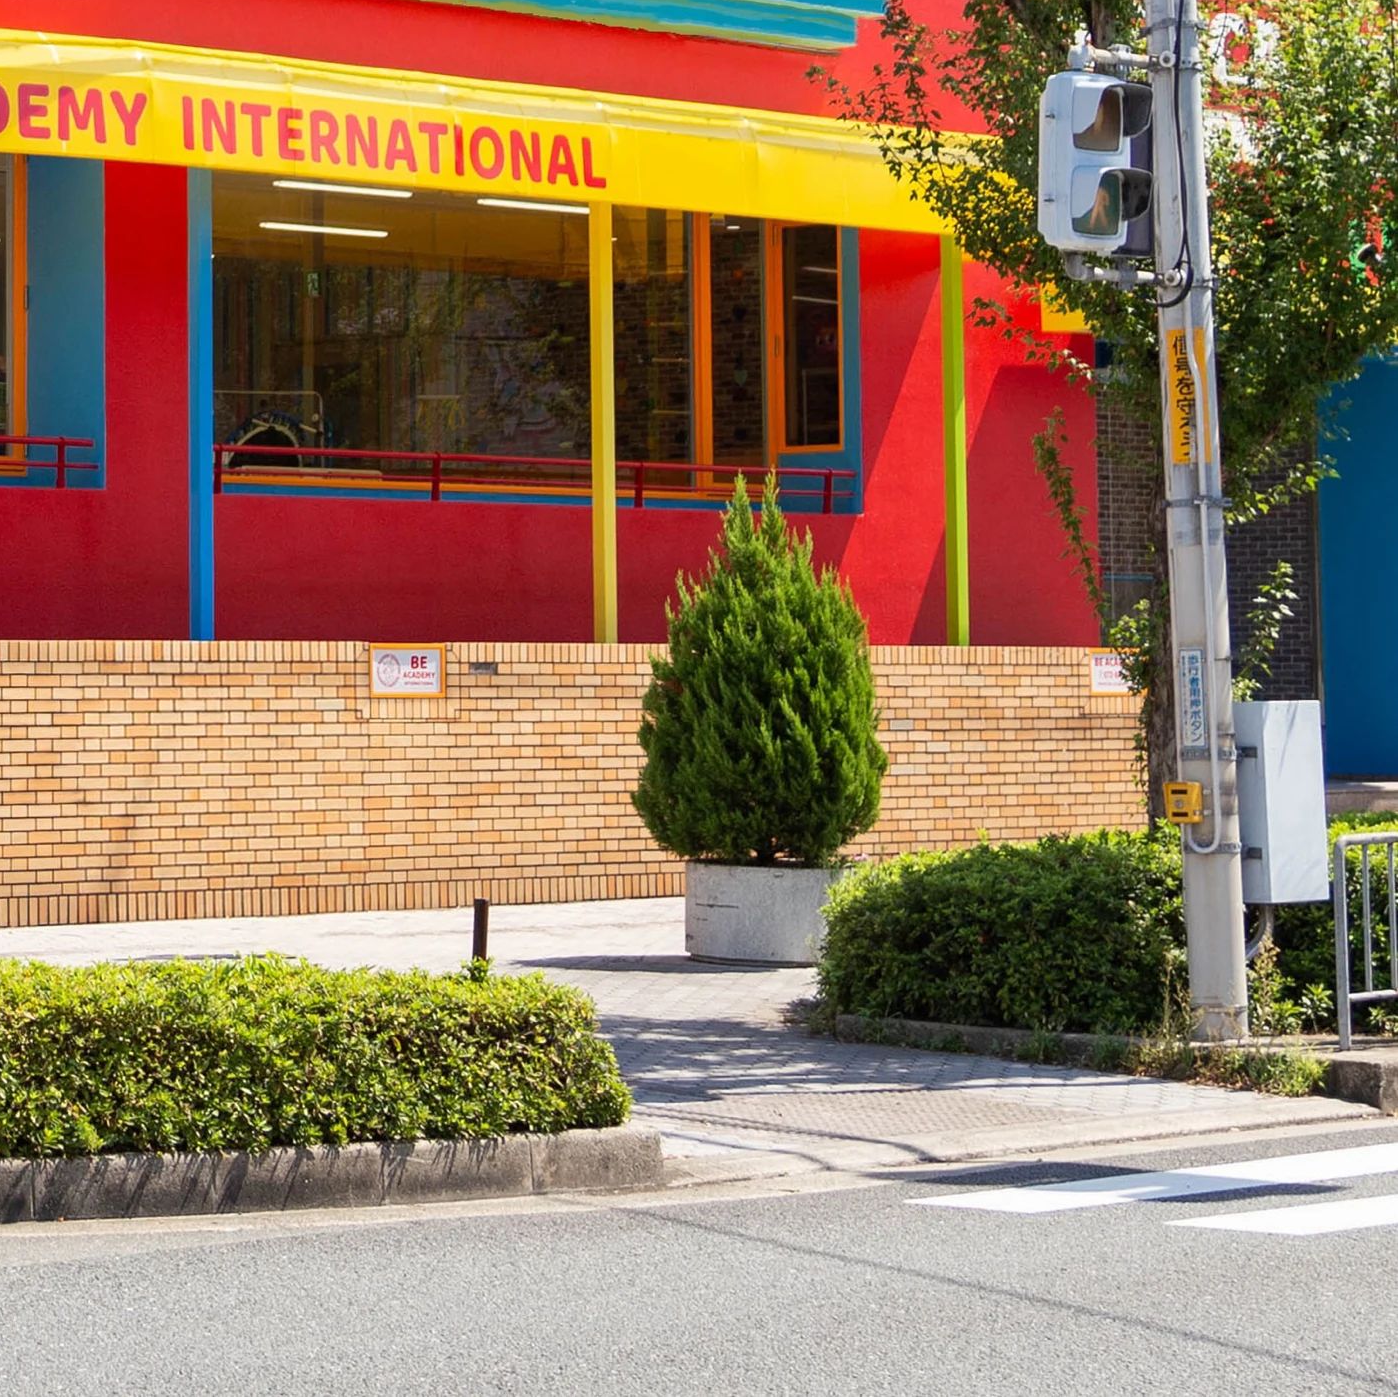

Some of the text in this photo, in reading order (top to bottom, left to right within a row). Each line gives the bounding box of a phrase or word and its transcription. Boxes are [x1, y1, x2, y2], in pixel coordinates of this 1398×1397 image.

[182, 95, 607, 190] INTERNATIONAL
[410, 655, 428, 669] BE
[403, 671, 435, 679] ACADEMY
